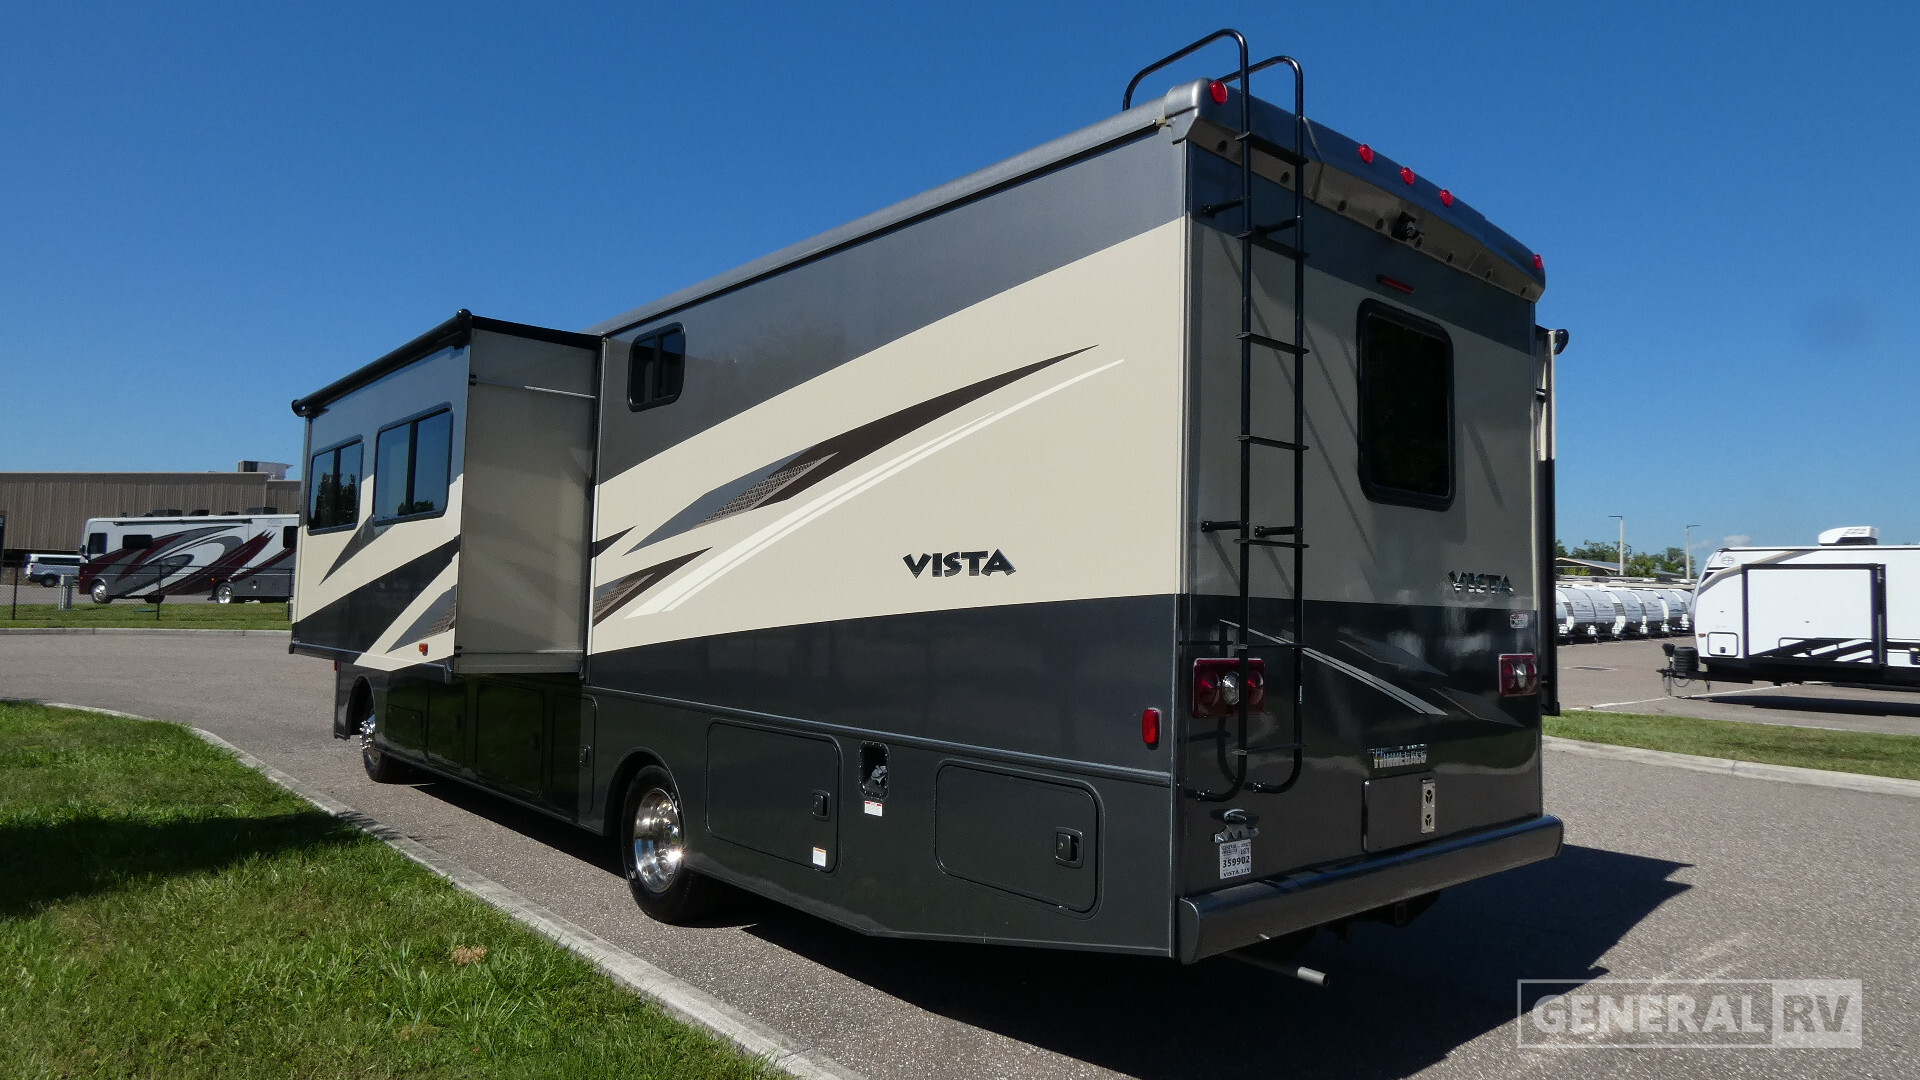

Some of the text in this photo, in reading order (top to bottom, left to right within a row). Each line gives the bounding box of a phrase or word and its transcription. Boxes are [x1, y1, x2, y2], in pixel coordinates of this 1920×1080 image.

[903, 549, 1016, 578] VISTA
[1448, 571, 1514, 596] VISTA
[1223, 856, 1250, 868] 359902
